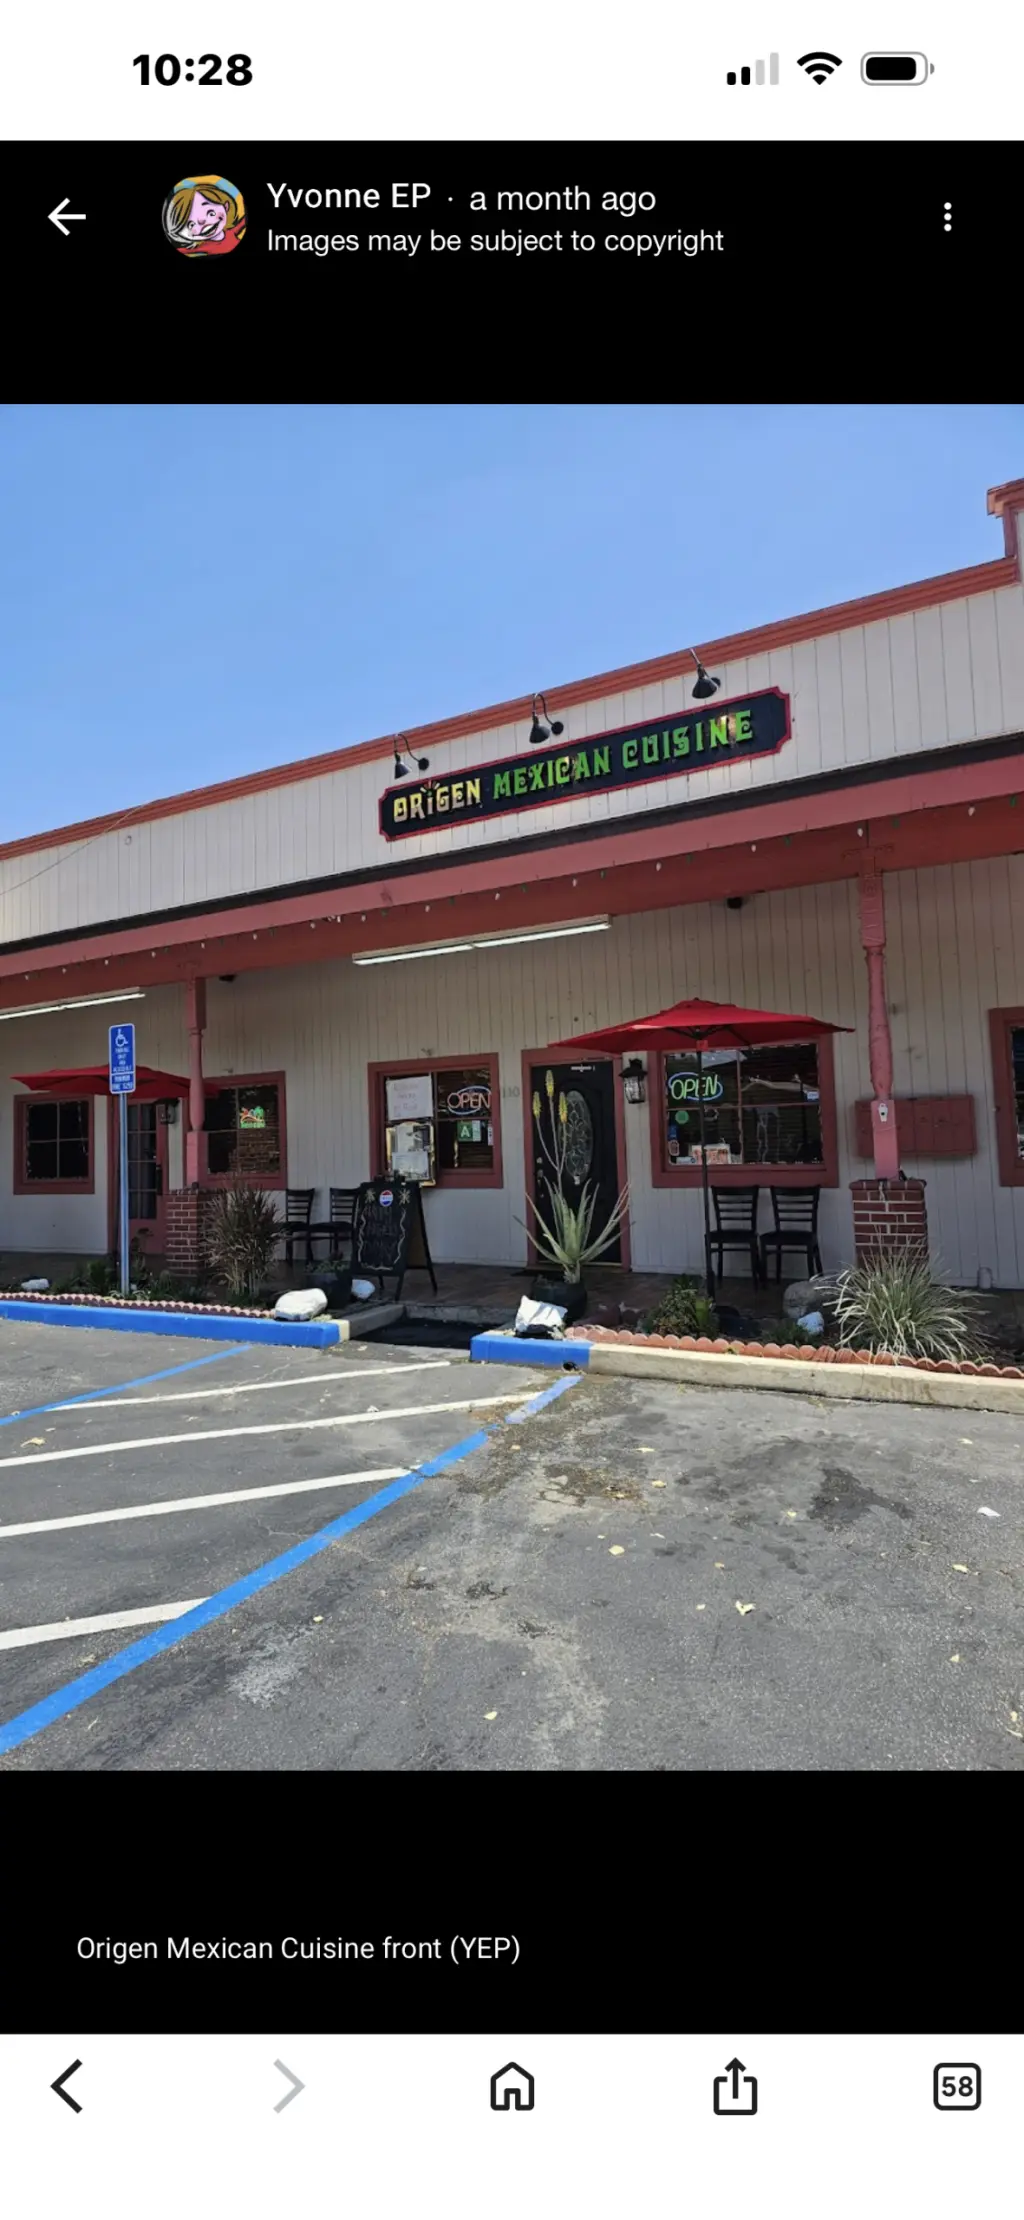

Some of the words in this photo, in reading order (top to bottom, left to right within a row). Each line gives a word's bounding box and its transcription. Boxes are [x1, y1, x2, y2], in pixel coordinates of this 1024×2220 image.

[393, 777, 481, 823] ORIGEN
[493, 745, 611, 800] MEXICAN
[622, 708, 755, 770] CUISINE
[670, 1074, 718, 1101] OPEN
[447, 1092, 492, 1109] OPEN
[460, 1125, 471, 1138] A
